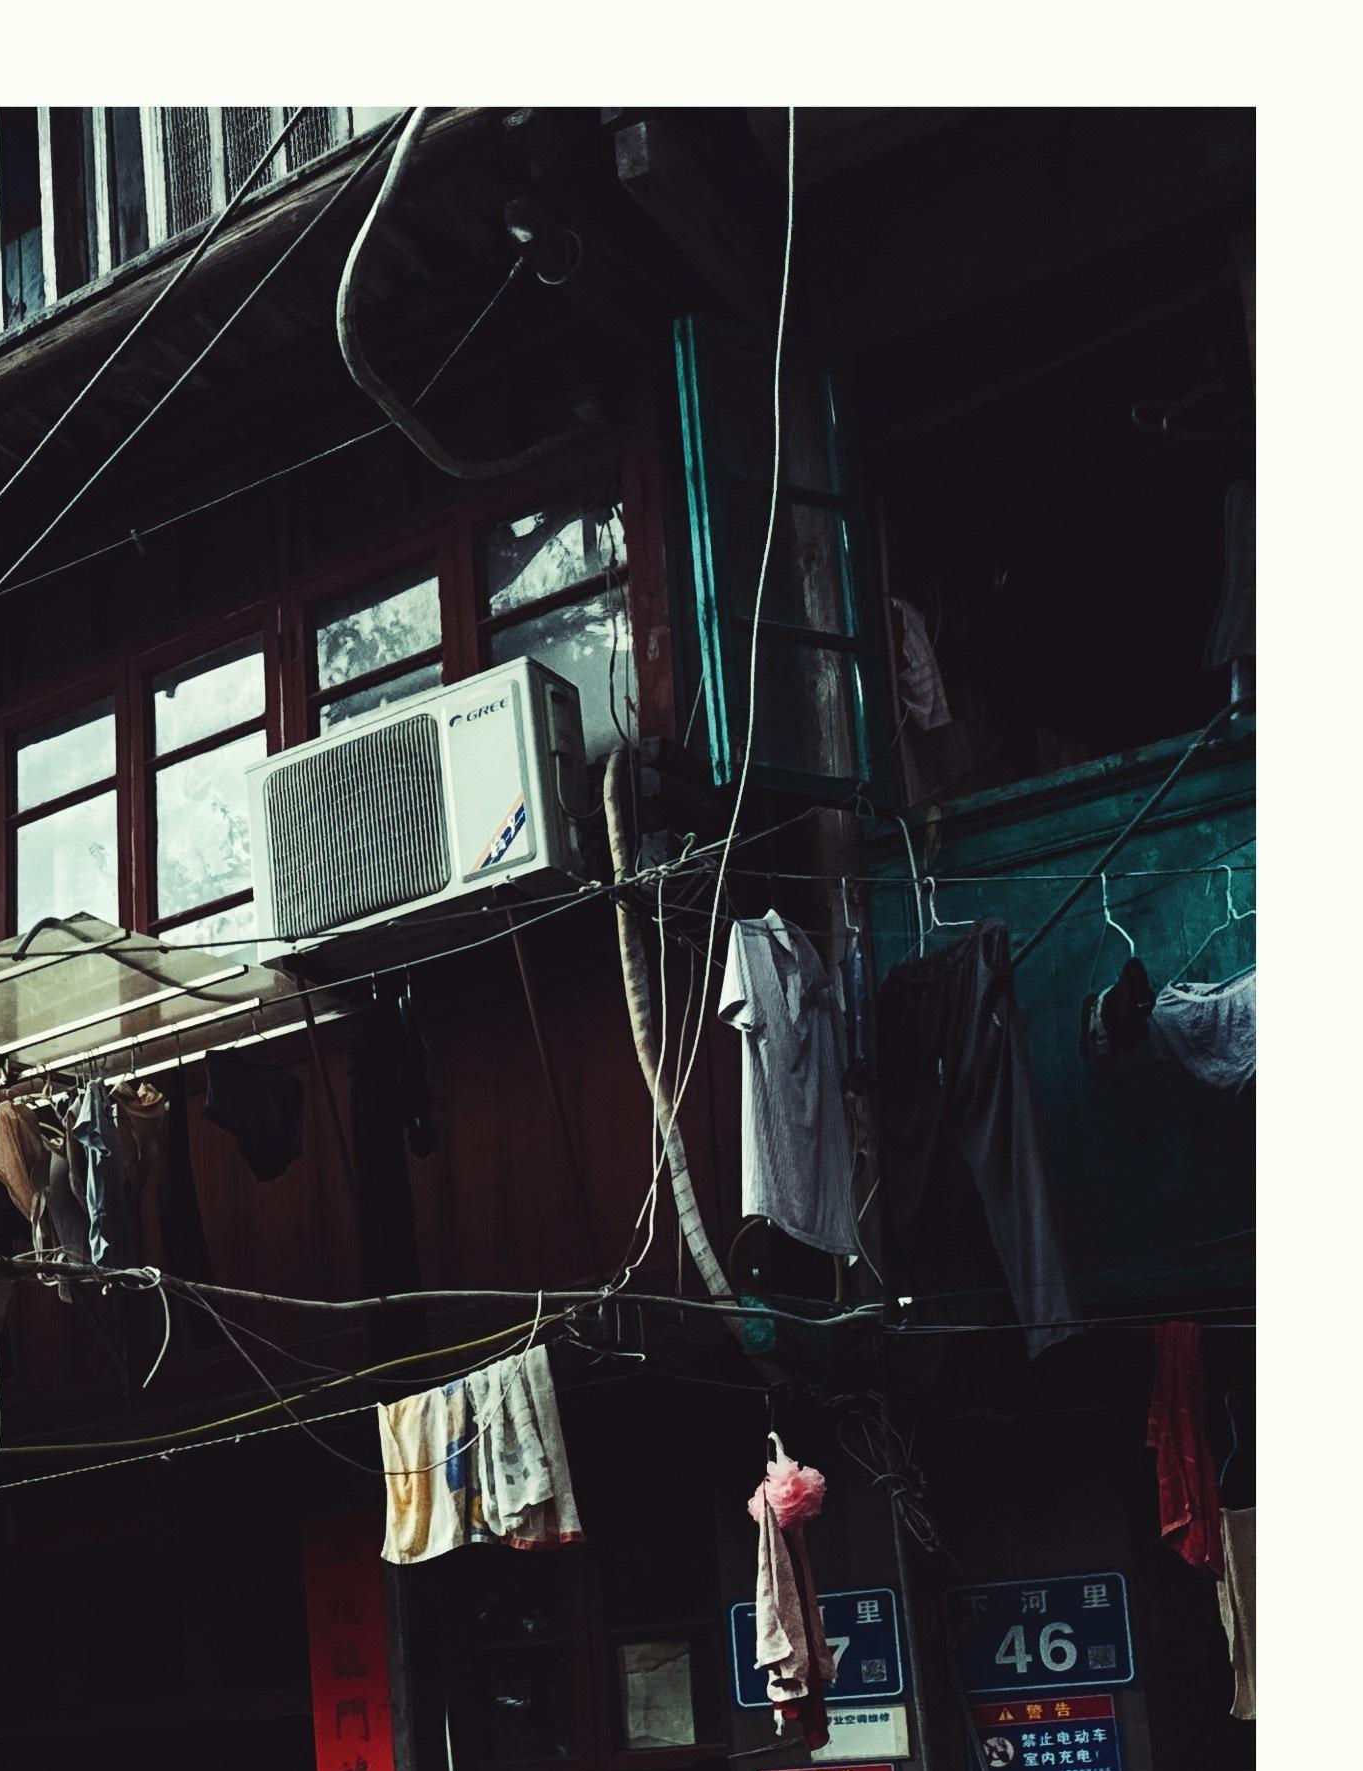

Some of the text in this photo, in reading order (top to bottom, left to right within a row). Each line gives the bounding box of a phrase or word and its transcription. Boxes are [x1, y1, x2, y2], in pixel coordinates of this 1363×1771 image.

[465, 697, 510, 722] GREE
[960, 1583, 1111, 1617] 下河里
[995, 1621, 1078, 1674] 46
[1025, 1702, 1071, 1720] 警告
[1021, 1727, 1108, 1748] 禁止电动车
[1022, 1748, 1101, 1767] 室内充电！
